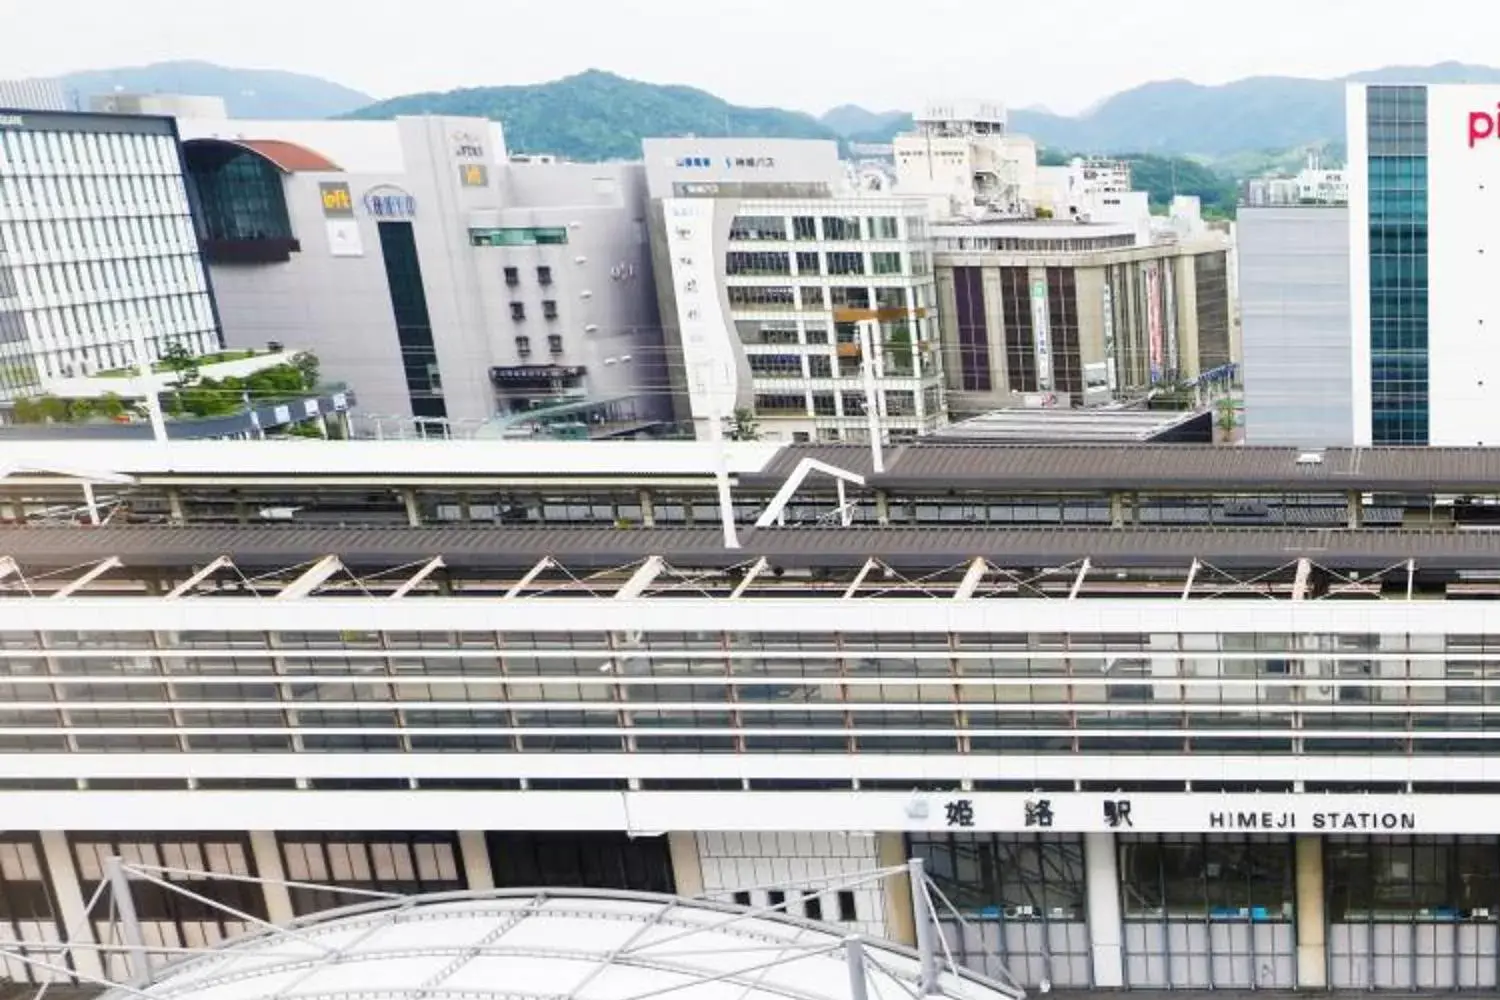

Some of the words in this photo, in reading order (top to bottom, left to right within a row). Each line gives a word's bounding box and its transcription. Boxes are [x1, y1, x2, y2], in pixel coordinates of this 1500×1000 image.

[944, 800, 1133, 828] 姫路駅
[1210, 812, 1295, 829] HIMEJI
[1312, 812, 1416, 829] STATION
